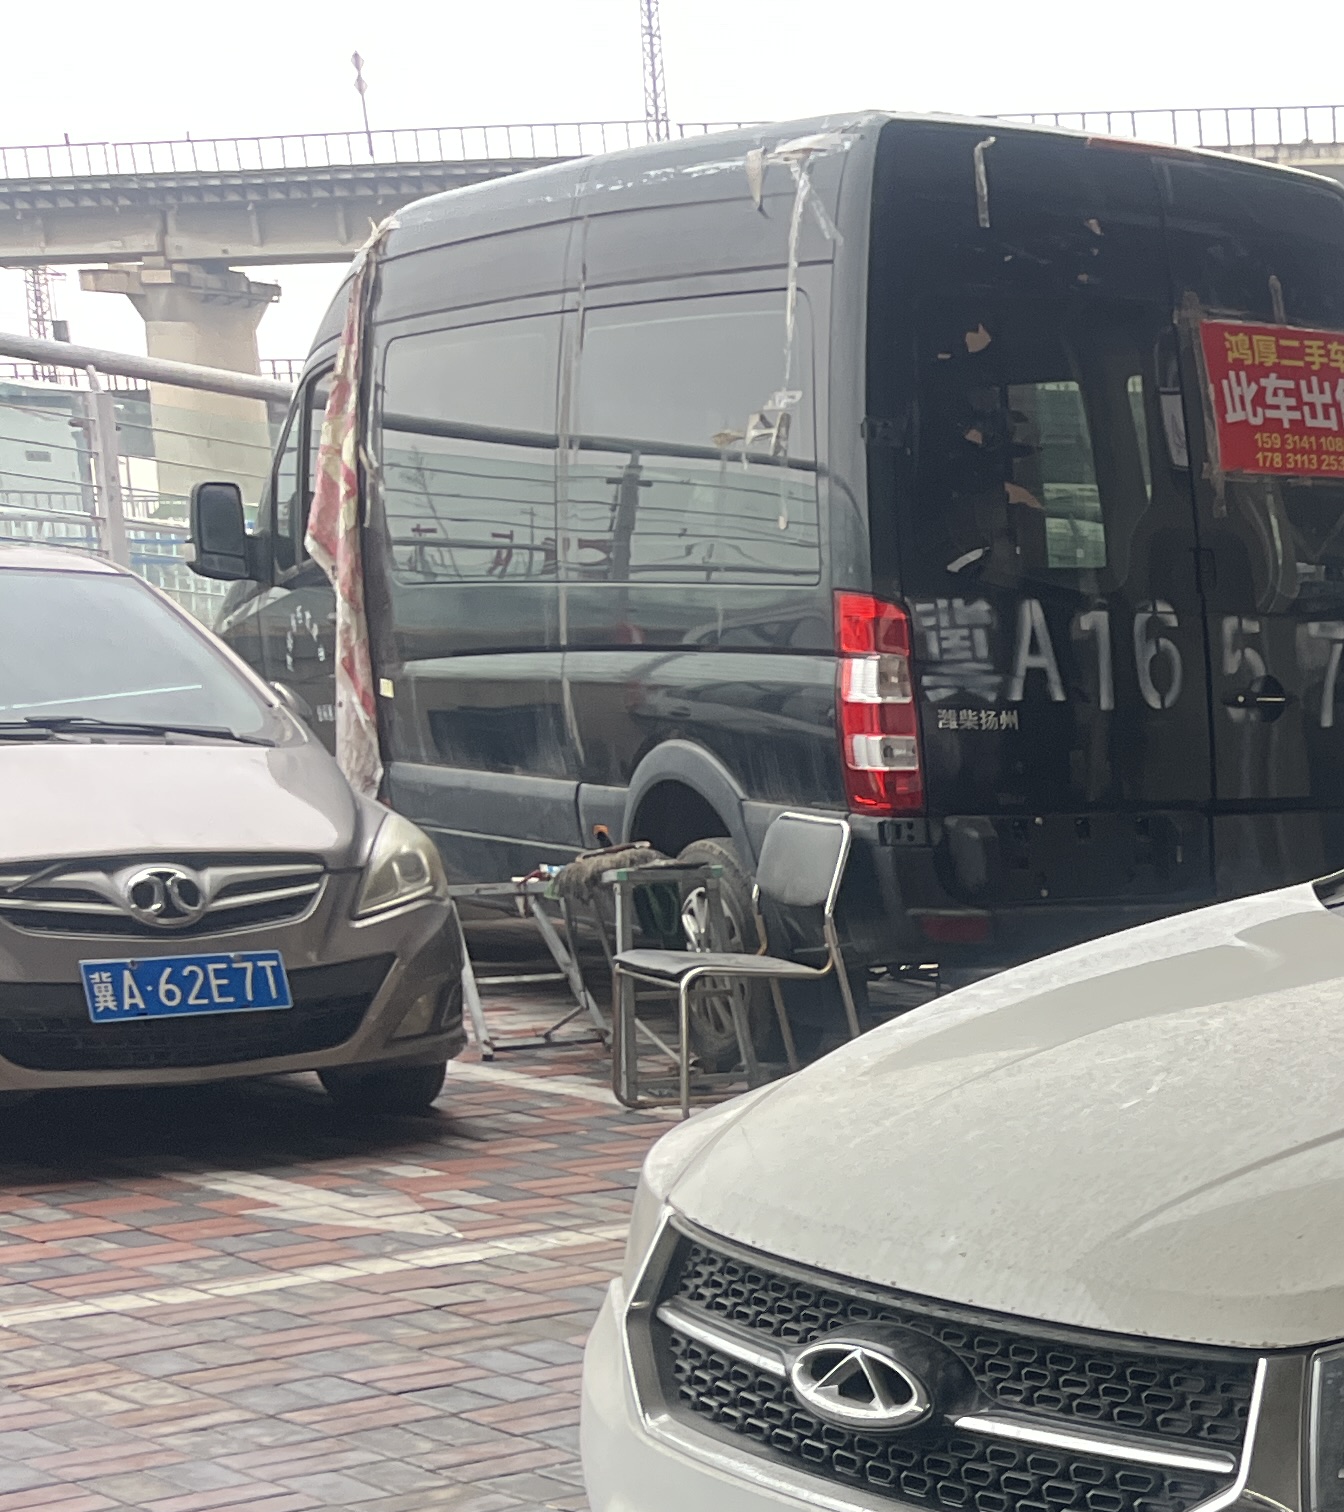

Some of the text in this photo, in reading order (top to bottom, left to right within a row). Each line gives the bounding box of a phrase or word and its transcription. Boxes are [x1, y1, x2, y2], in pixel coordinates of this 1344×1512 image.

[1254, 432, 1281, 448] 159
[1284, 434, 1317, 450] 3141
[1255, 452, 1283, 468] 178
[1286, 453, 1318, 469] 3113
